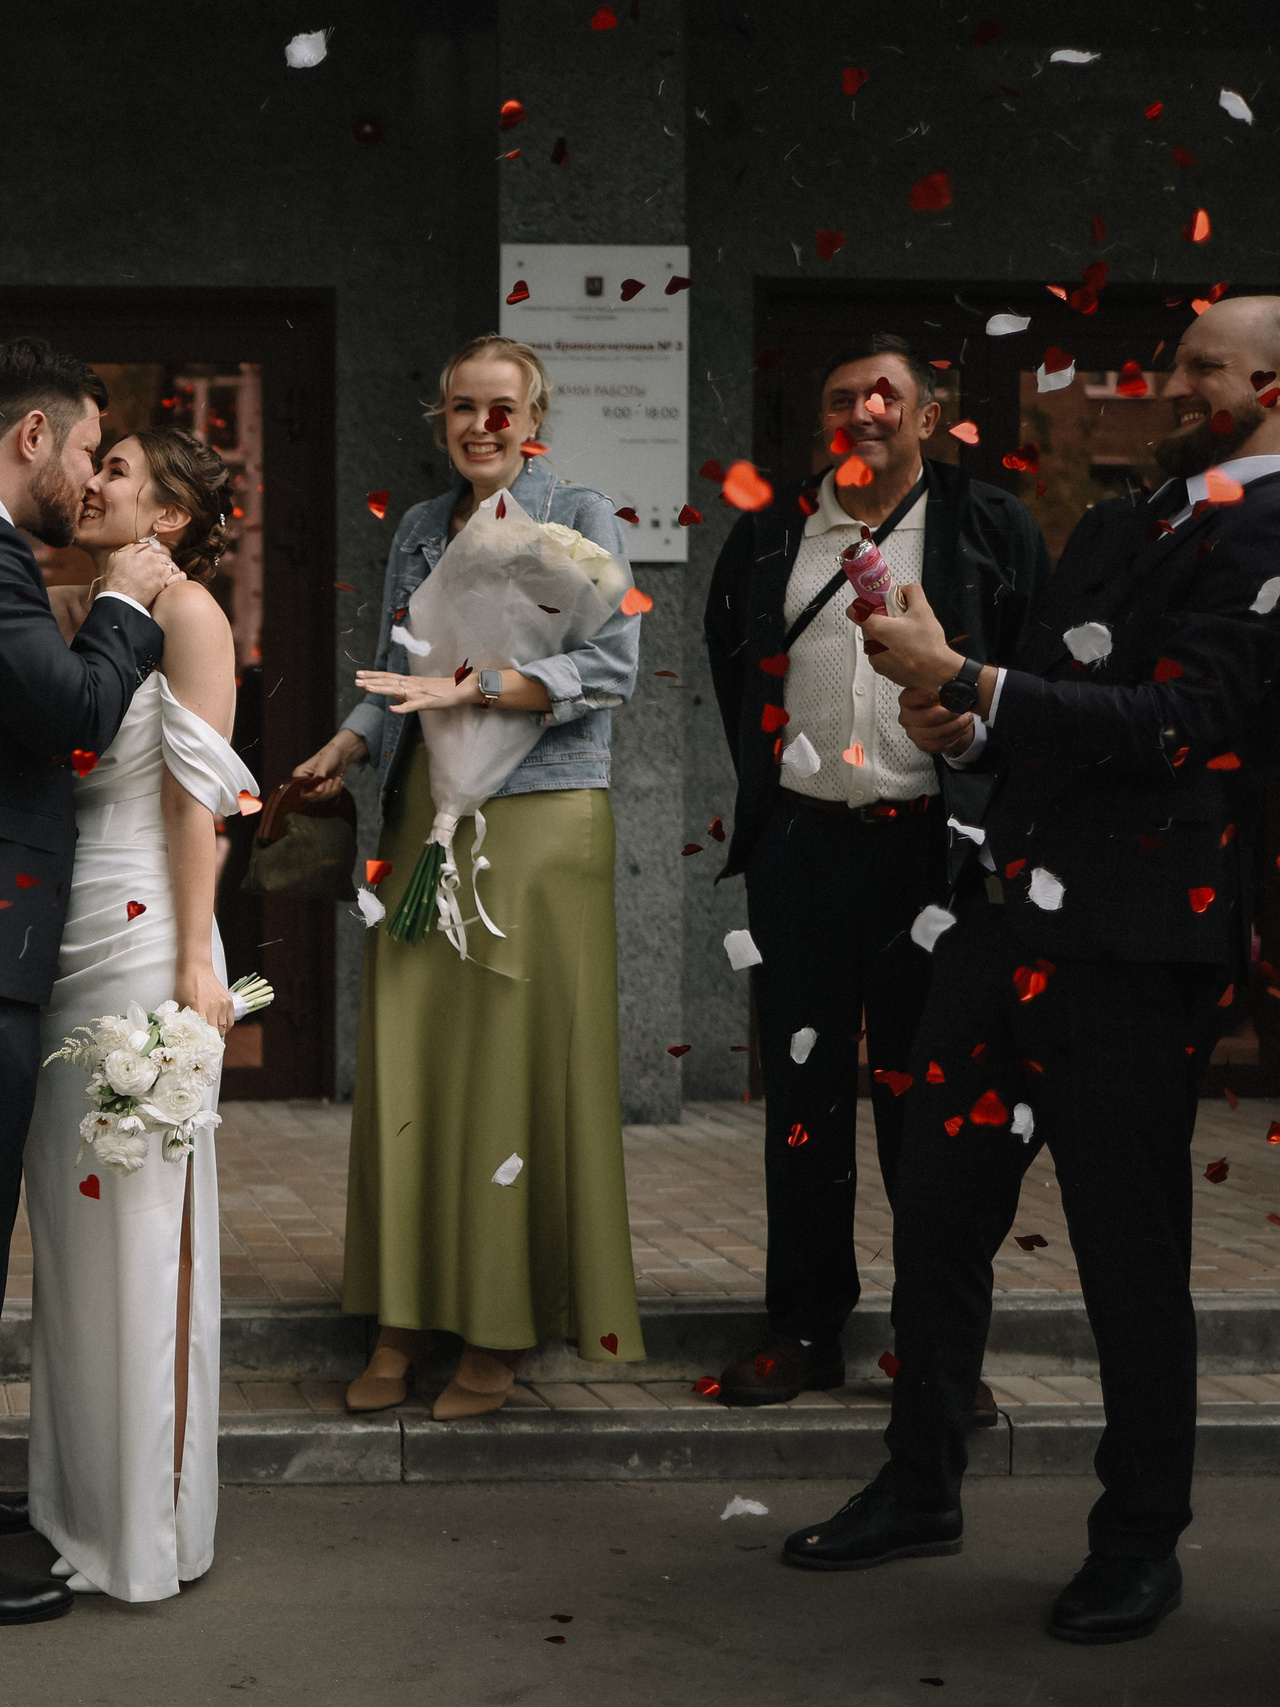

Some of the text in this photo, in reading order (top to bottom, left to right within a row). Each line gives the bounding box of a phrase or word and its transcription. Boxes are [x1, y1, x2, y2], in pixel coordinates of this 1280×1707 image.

[554, 339, 654, 353] бракосочетания
[674, 340, 683, 350] 3
[593, 384, 646, 397] РАБОТЫ
